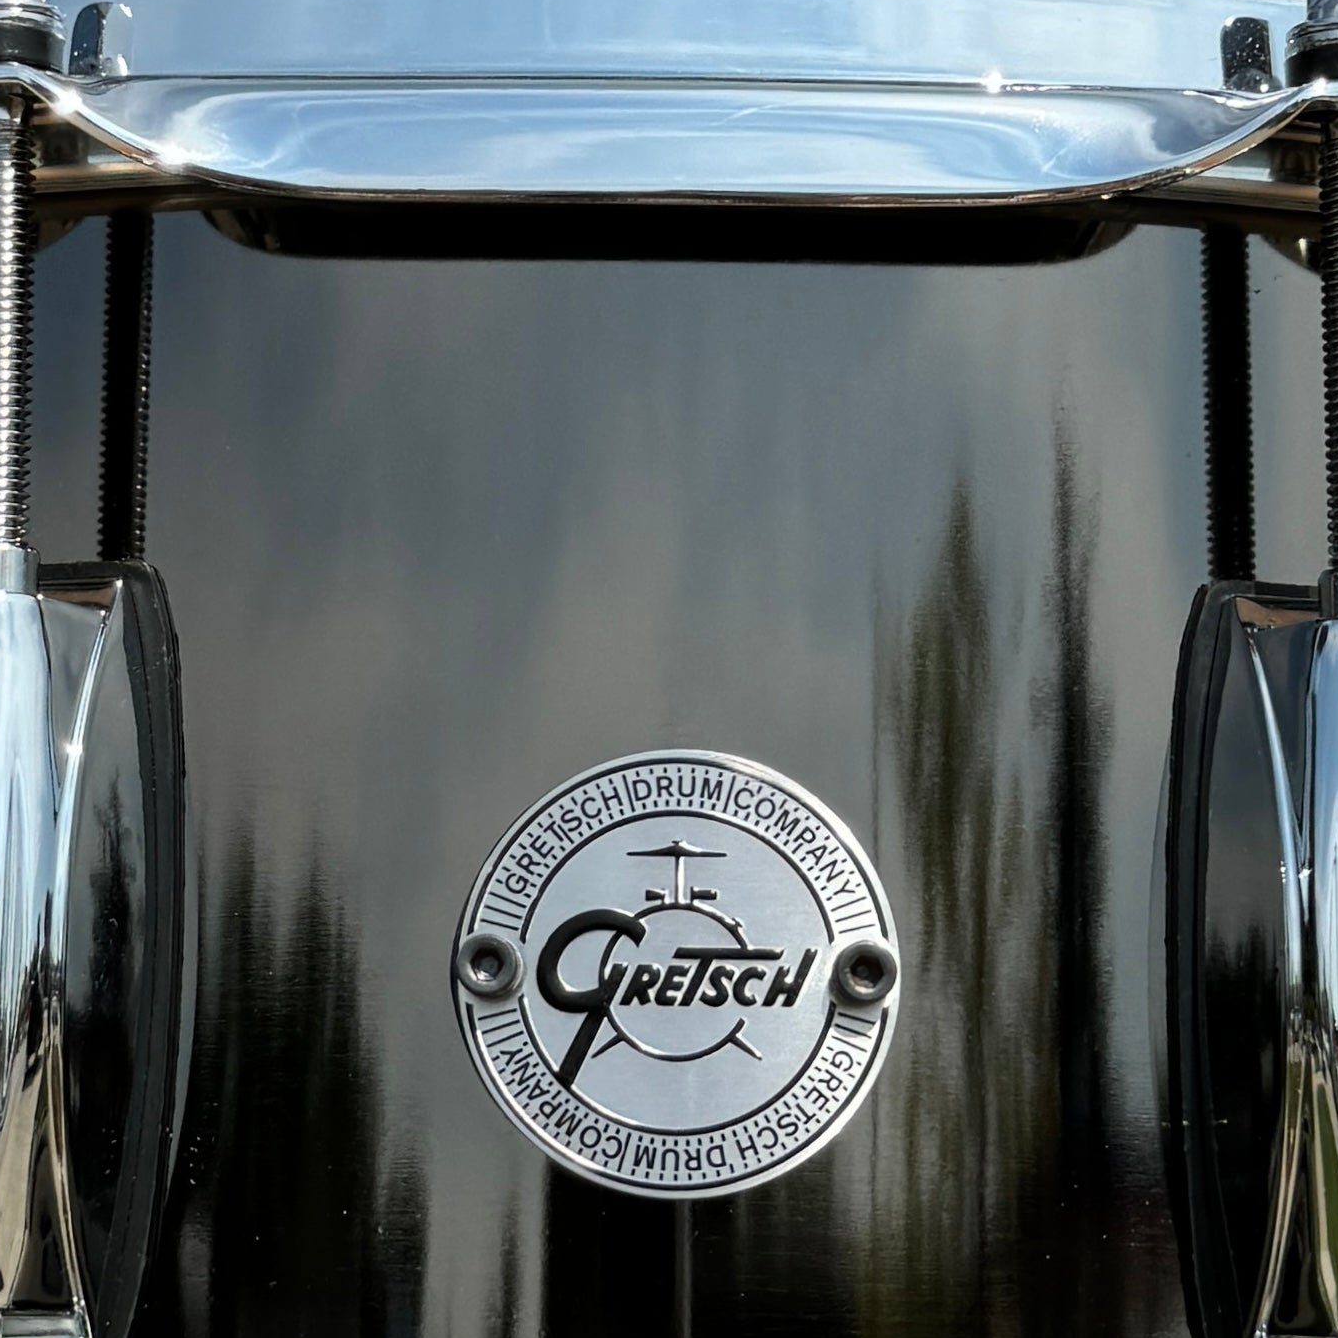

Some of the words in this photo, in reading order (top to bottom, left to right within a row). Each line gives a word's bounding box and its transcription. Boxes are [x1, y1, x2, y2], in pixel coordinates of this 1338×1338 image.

[505, 788, 623, 896] GRETSCH
[632, 774, 725, 803] DRUM
[734, 787, 856, 897] COMPANY
[499, 1045, 623, 1160] COMPANY
[634, 1145, 726, 1170] DRUM
[735, 1049, 855, 1162] GRETSCH
